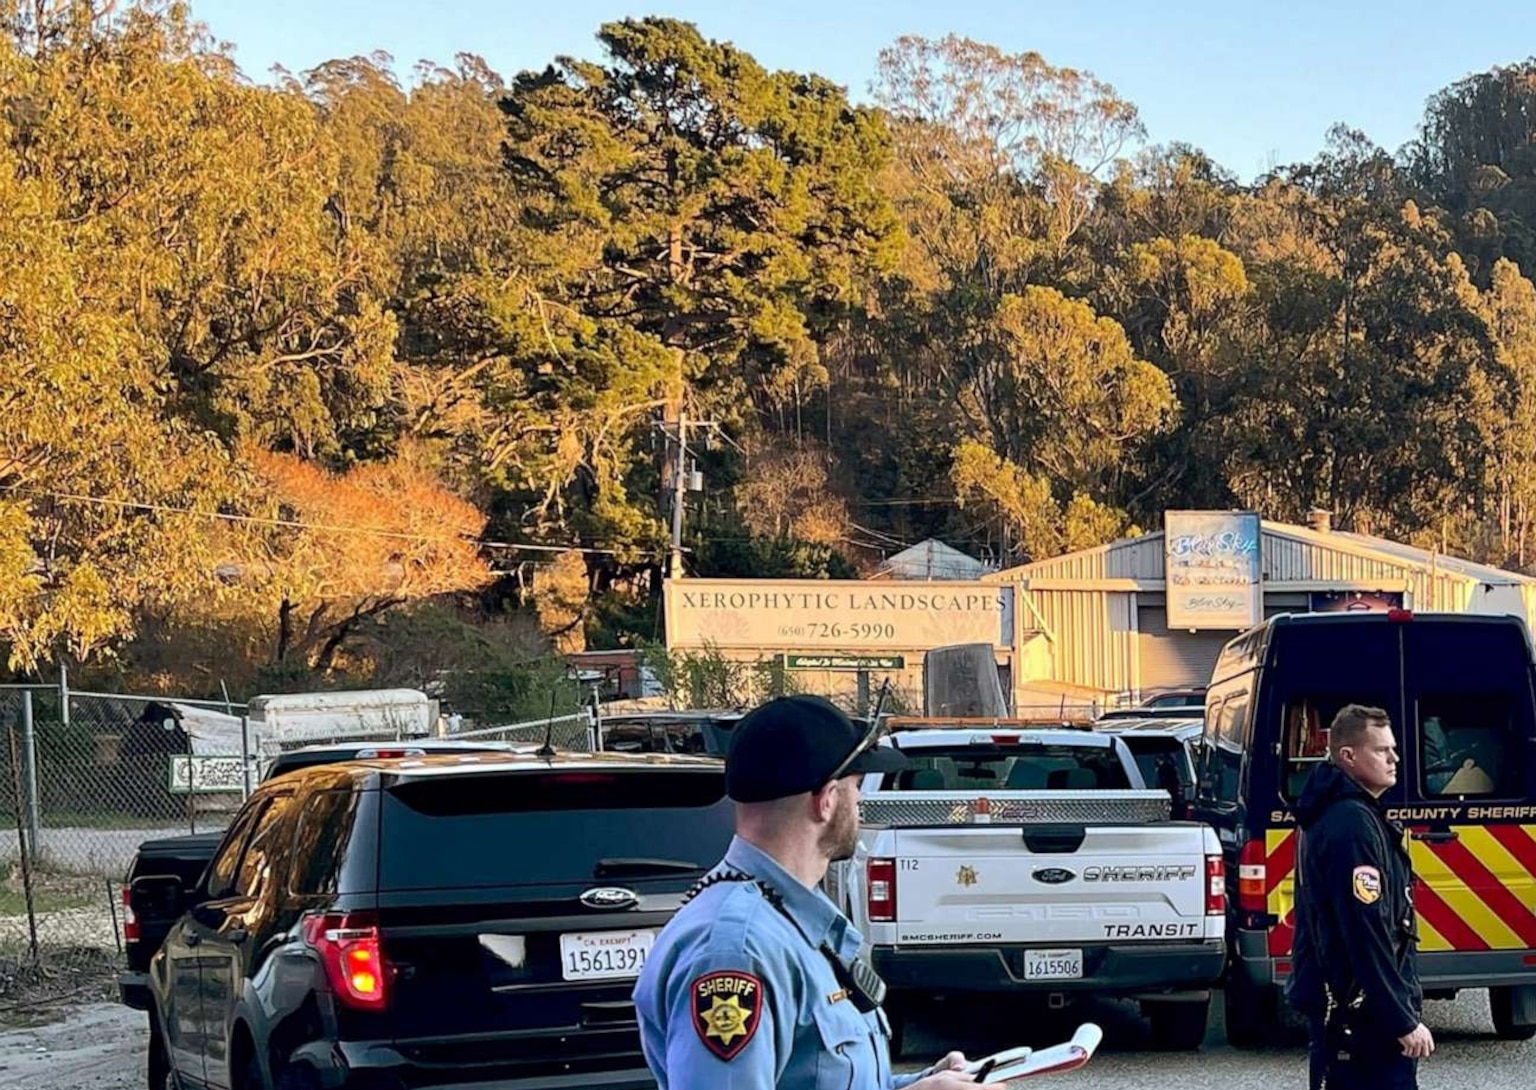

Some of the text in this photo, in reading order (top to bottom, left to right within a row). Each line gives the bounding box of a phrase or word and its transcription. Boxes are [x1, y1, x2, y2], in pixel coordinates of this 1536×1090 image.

[682, 592, 1006, 612] XEROPHYTIC LANDSCAPES
[778, 622, 895, 639] (650) 726-5990
[1386, 808, 1461, 820] COUNTY
[1083, 865, 1196, 882] SHERIFF
[902, 933, 1002, 941] SMCSHERIFF.COM
[1104, 924, 1198, 937] TRANSIT
[569, 948, 647, 974] 1561391
[1029, 960, 1080, 975] 1615506
[698, 978, 757, 998] SHERIFF
